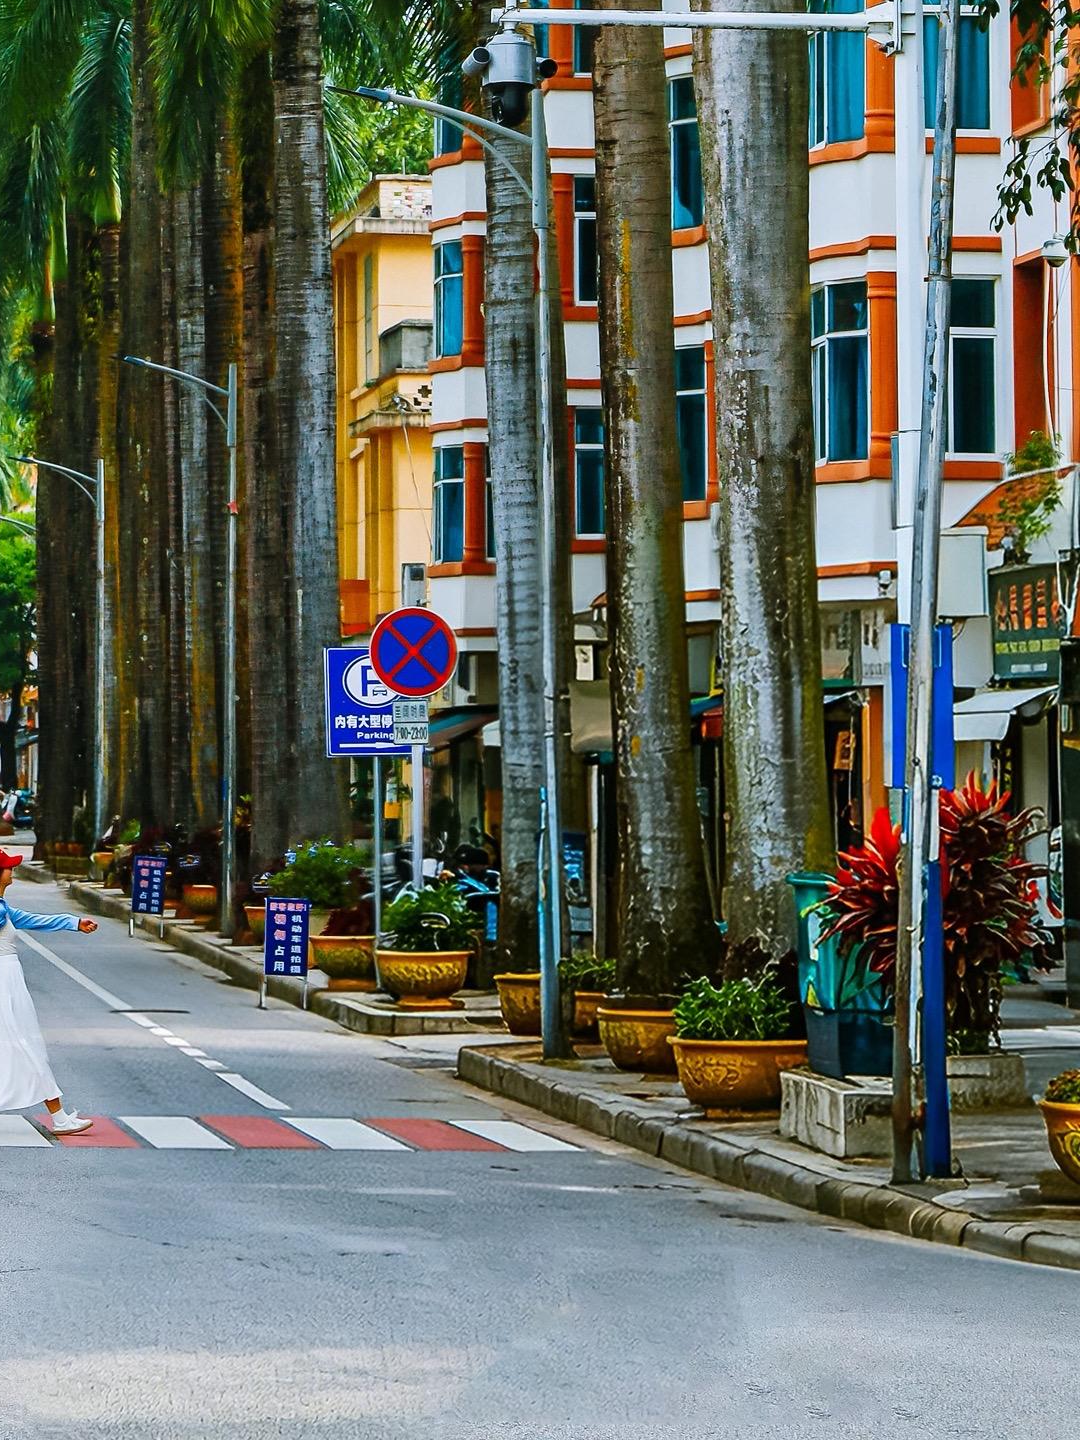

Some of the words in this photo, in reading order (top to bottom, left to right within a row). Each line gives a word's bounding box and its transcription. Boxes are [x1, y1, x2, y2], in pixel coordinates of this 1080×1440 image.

[335, 715, 393, 729] 内有大型停
[357, 731, 394, 740] Parking
